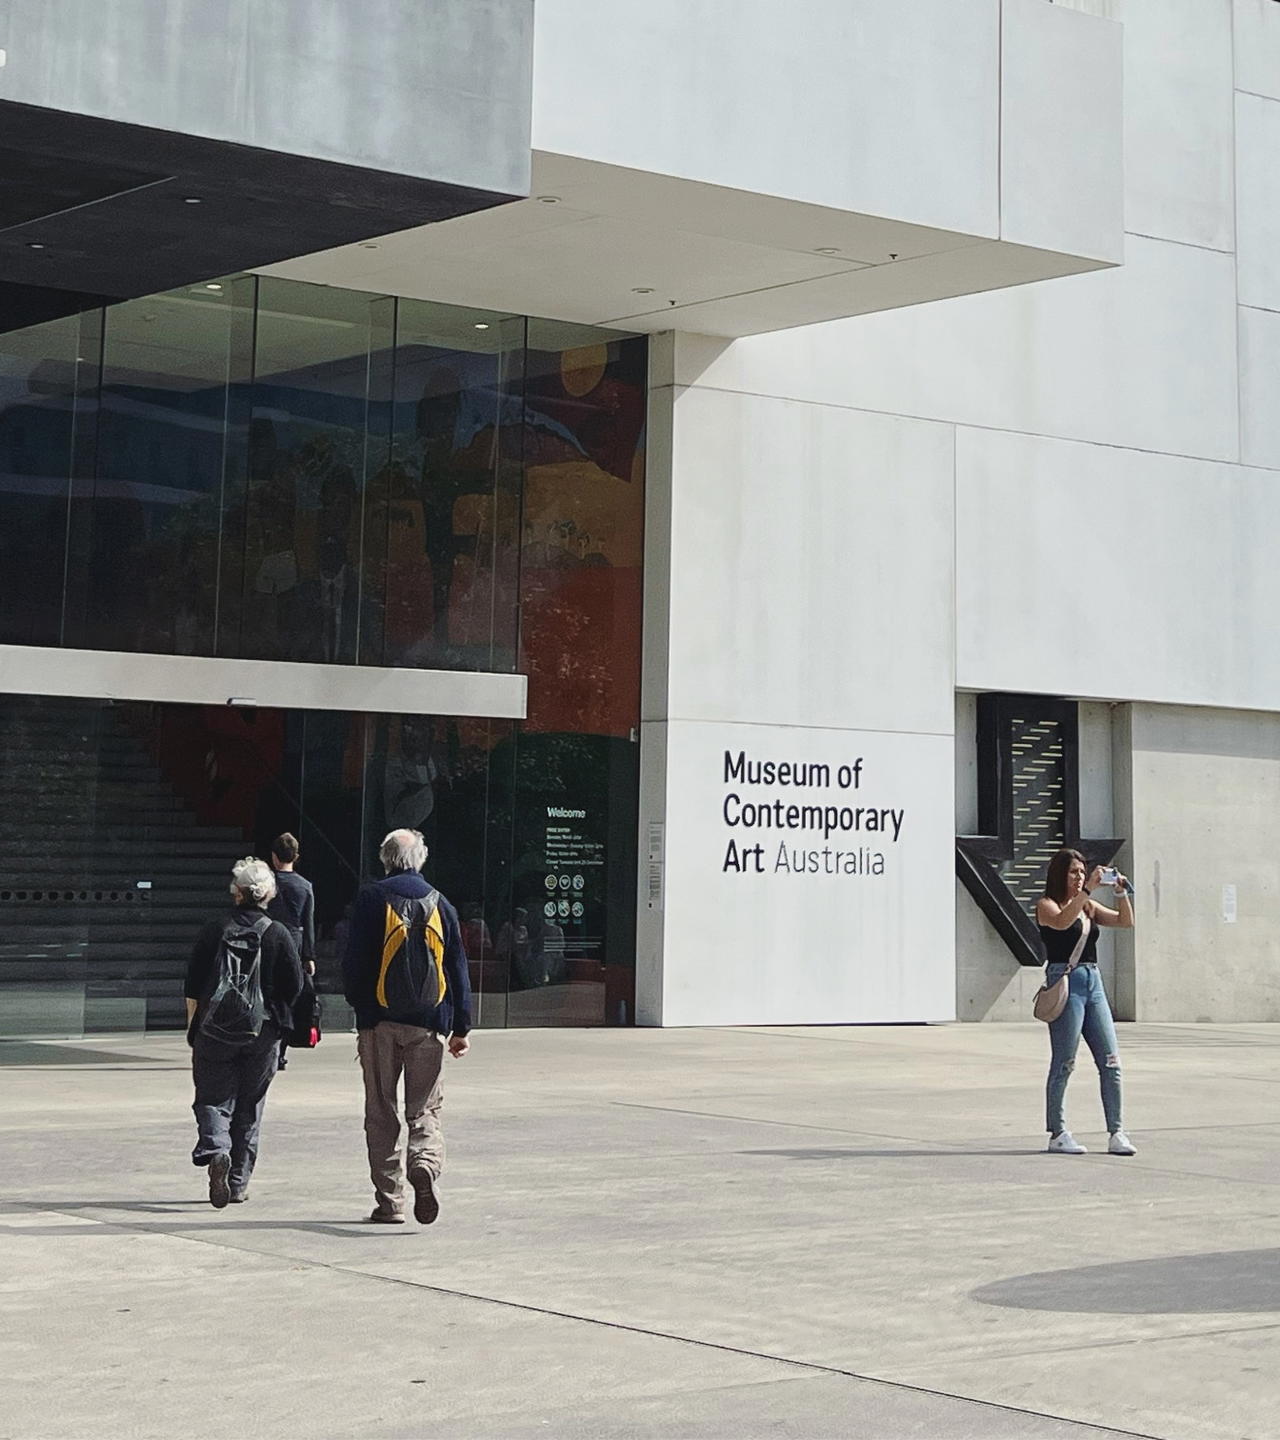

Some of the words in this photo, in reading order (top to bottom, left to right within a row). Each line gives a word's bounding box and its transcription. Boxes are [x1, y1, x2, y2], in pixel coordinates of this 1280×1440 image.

[723, 750, 830, 788] Museum
[837, 757, 863, 789] of
[547, 807, 586, 818] Welcome
[723, 793, 904, 842] Contemporary
[722, 839, 765, 873] Art
[774, 840, 885, 875] Australia
